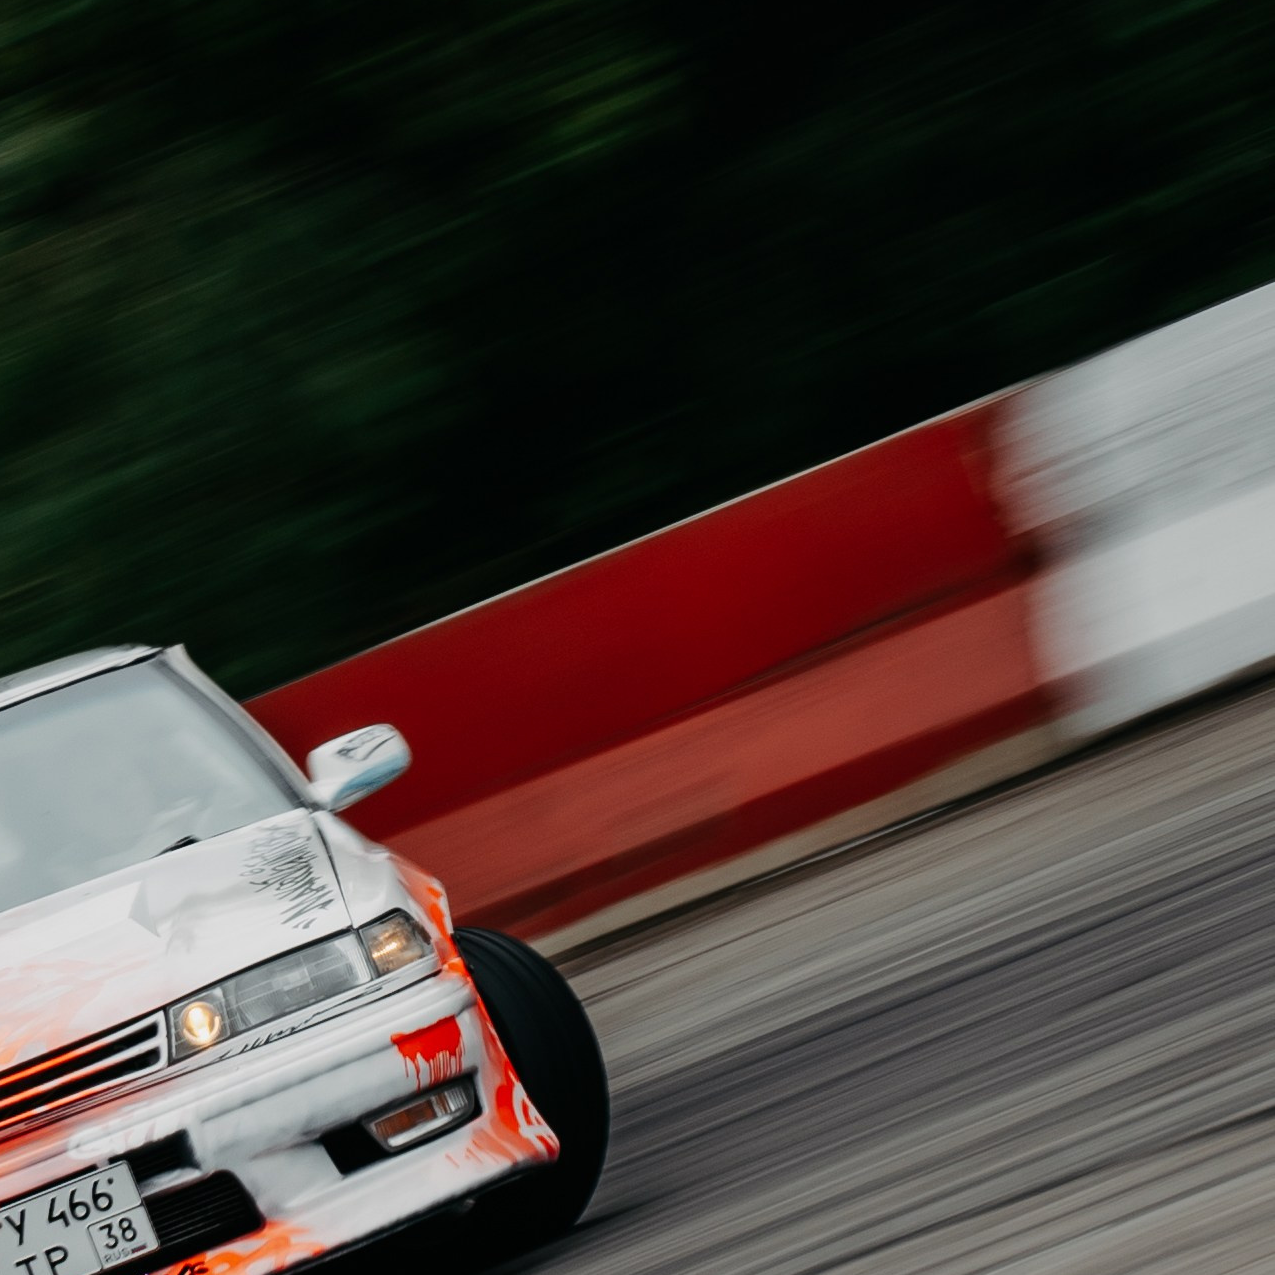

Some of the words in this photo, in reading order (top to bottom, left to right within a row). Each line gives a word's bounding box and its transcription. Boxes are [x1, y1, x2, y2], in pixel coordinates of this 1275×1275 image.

[46, 1179, 114, 1228] 466
[98, 1216, 138, 1250] 38
[103, 1247, 131, 1265] RUS
